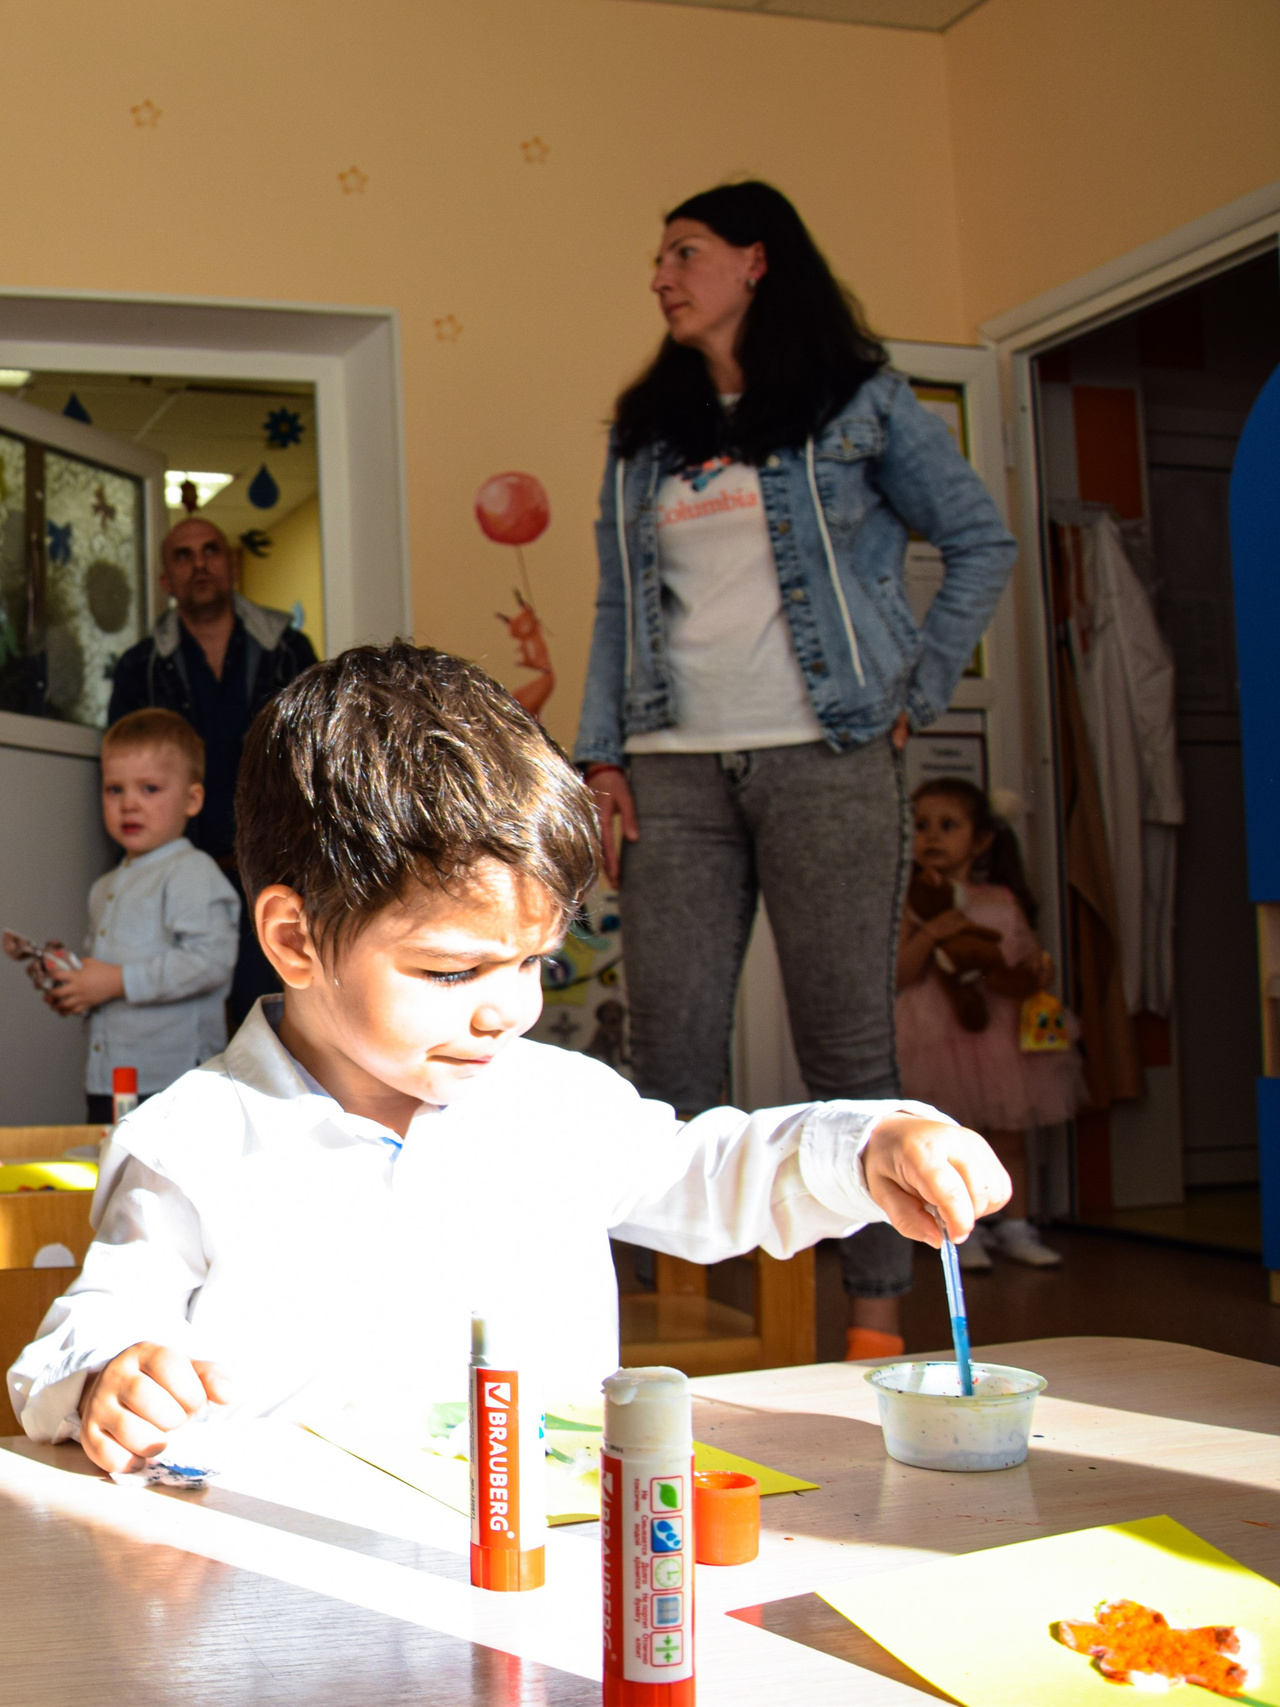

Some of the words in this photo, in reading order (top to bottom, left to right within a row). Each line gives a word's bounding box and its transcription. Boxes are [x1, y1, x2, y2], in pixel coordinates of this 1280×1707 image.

[488, 1411, 509, 1532] BRAUBERG
[641, 1514, 649, 1555] Смывается
[641, 1562, 649, 1584] Долго
[640, 1604, 648, 1629] портит
